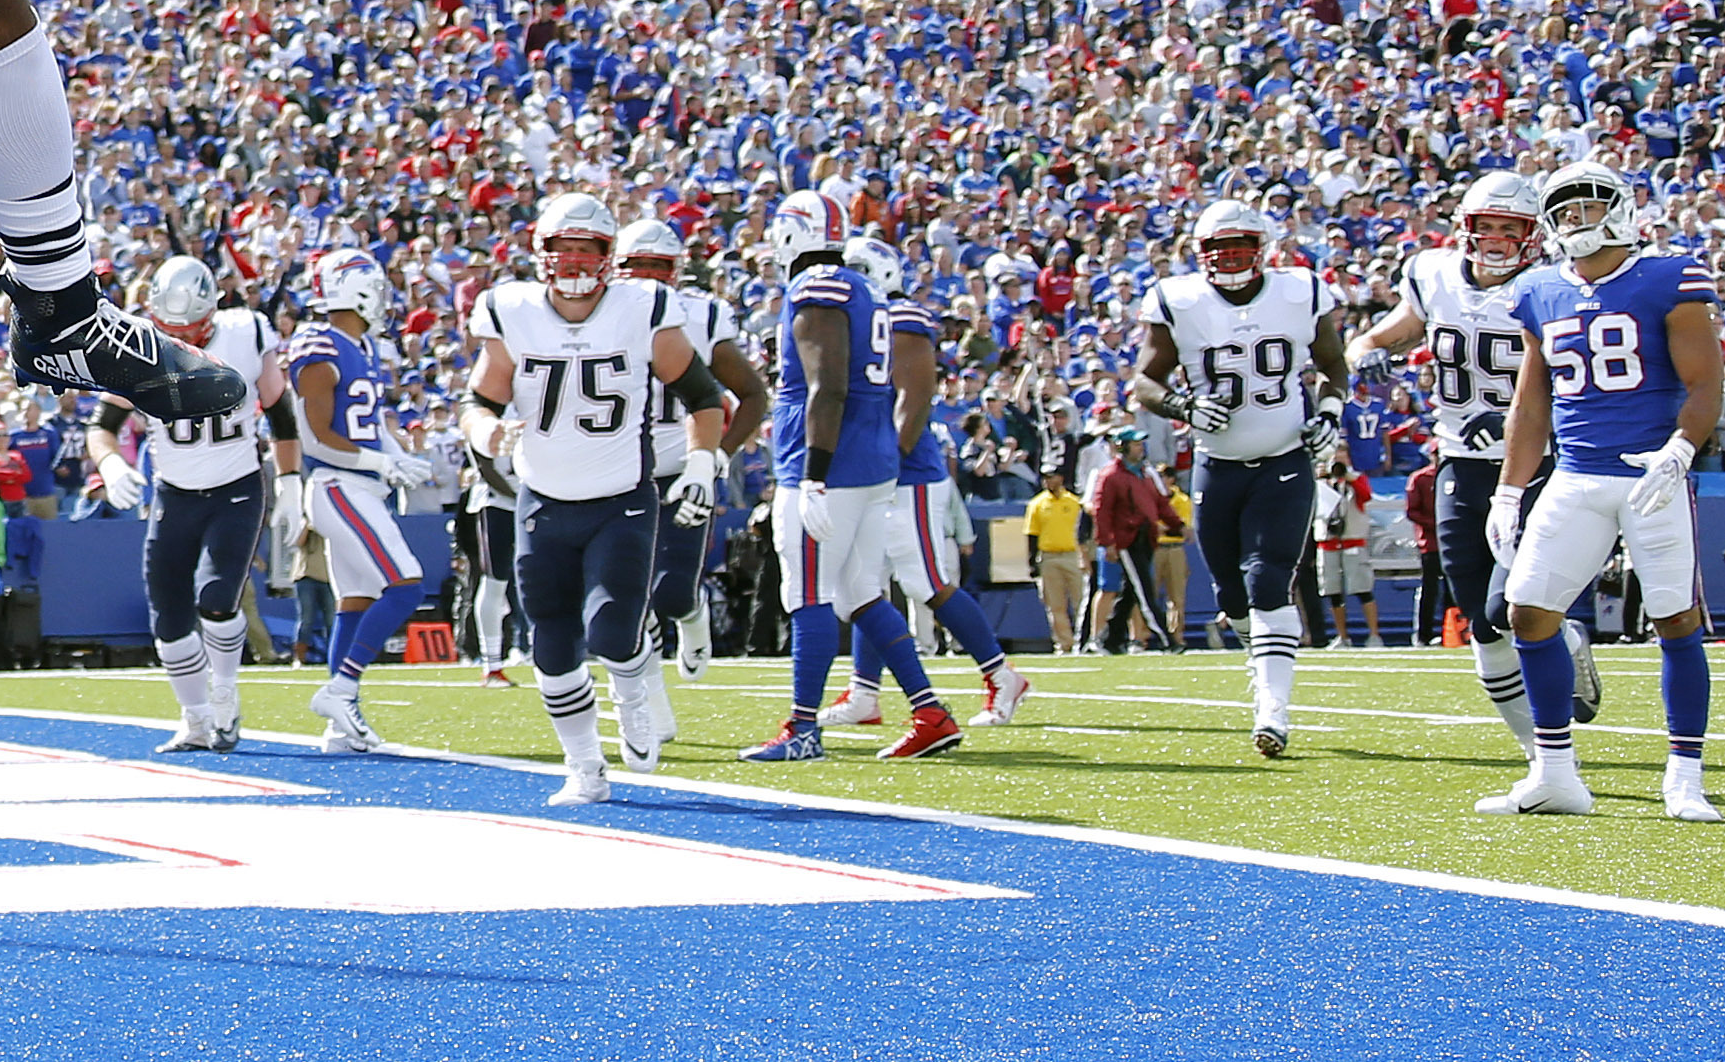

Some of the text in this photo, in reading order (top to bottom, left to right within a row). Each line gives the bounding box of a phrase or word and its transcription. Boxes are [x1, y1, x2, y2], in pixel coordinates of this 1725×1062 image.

[521, 349, 631, 438] 75
[1198, 333, 1294, 411] 69
[1433, 323, 1525, 411] 85
[1542, 312, 1644, 396] 58
[1357, 413, 1379, 439] 17
[418, 630, 451, 661] 10
